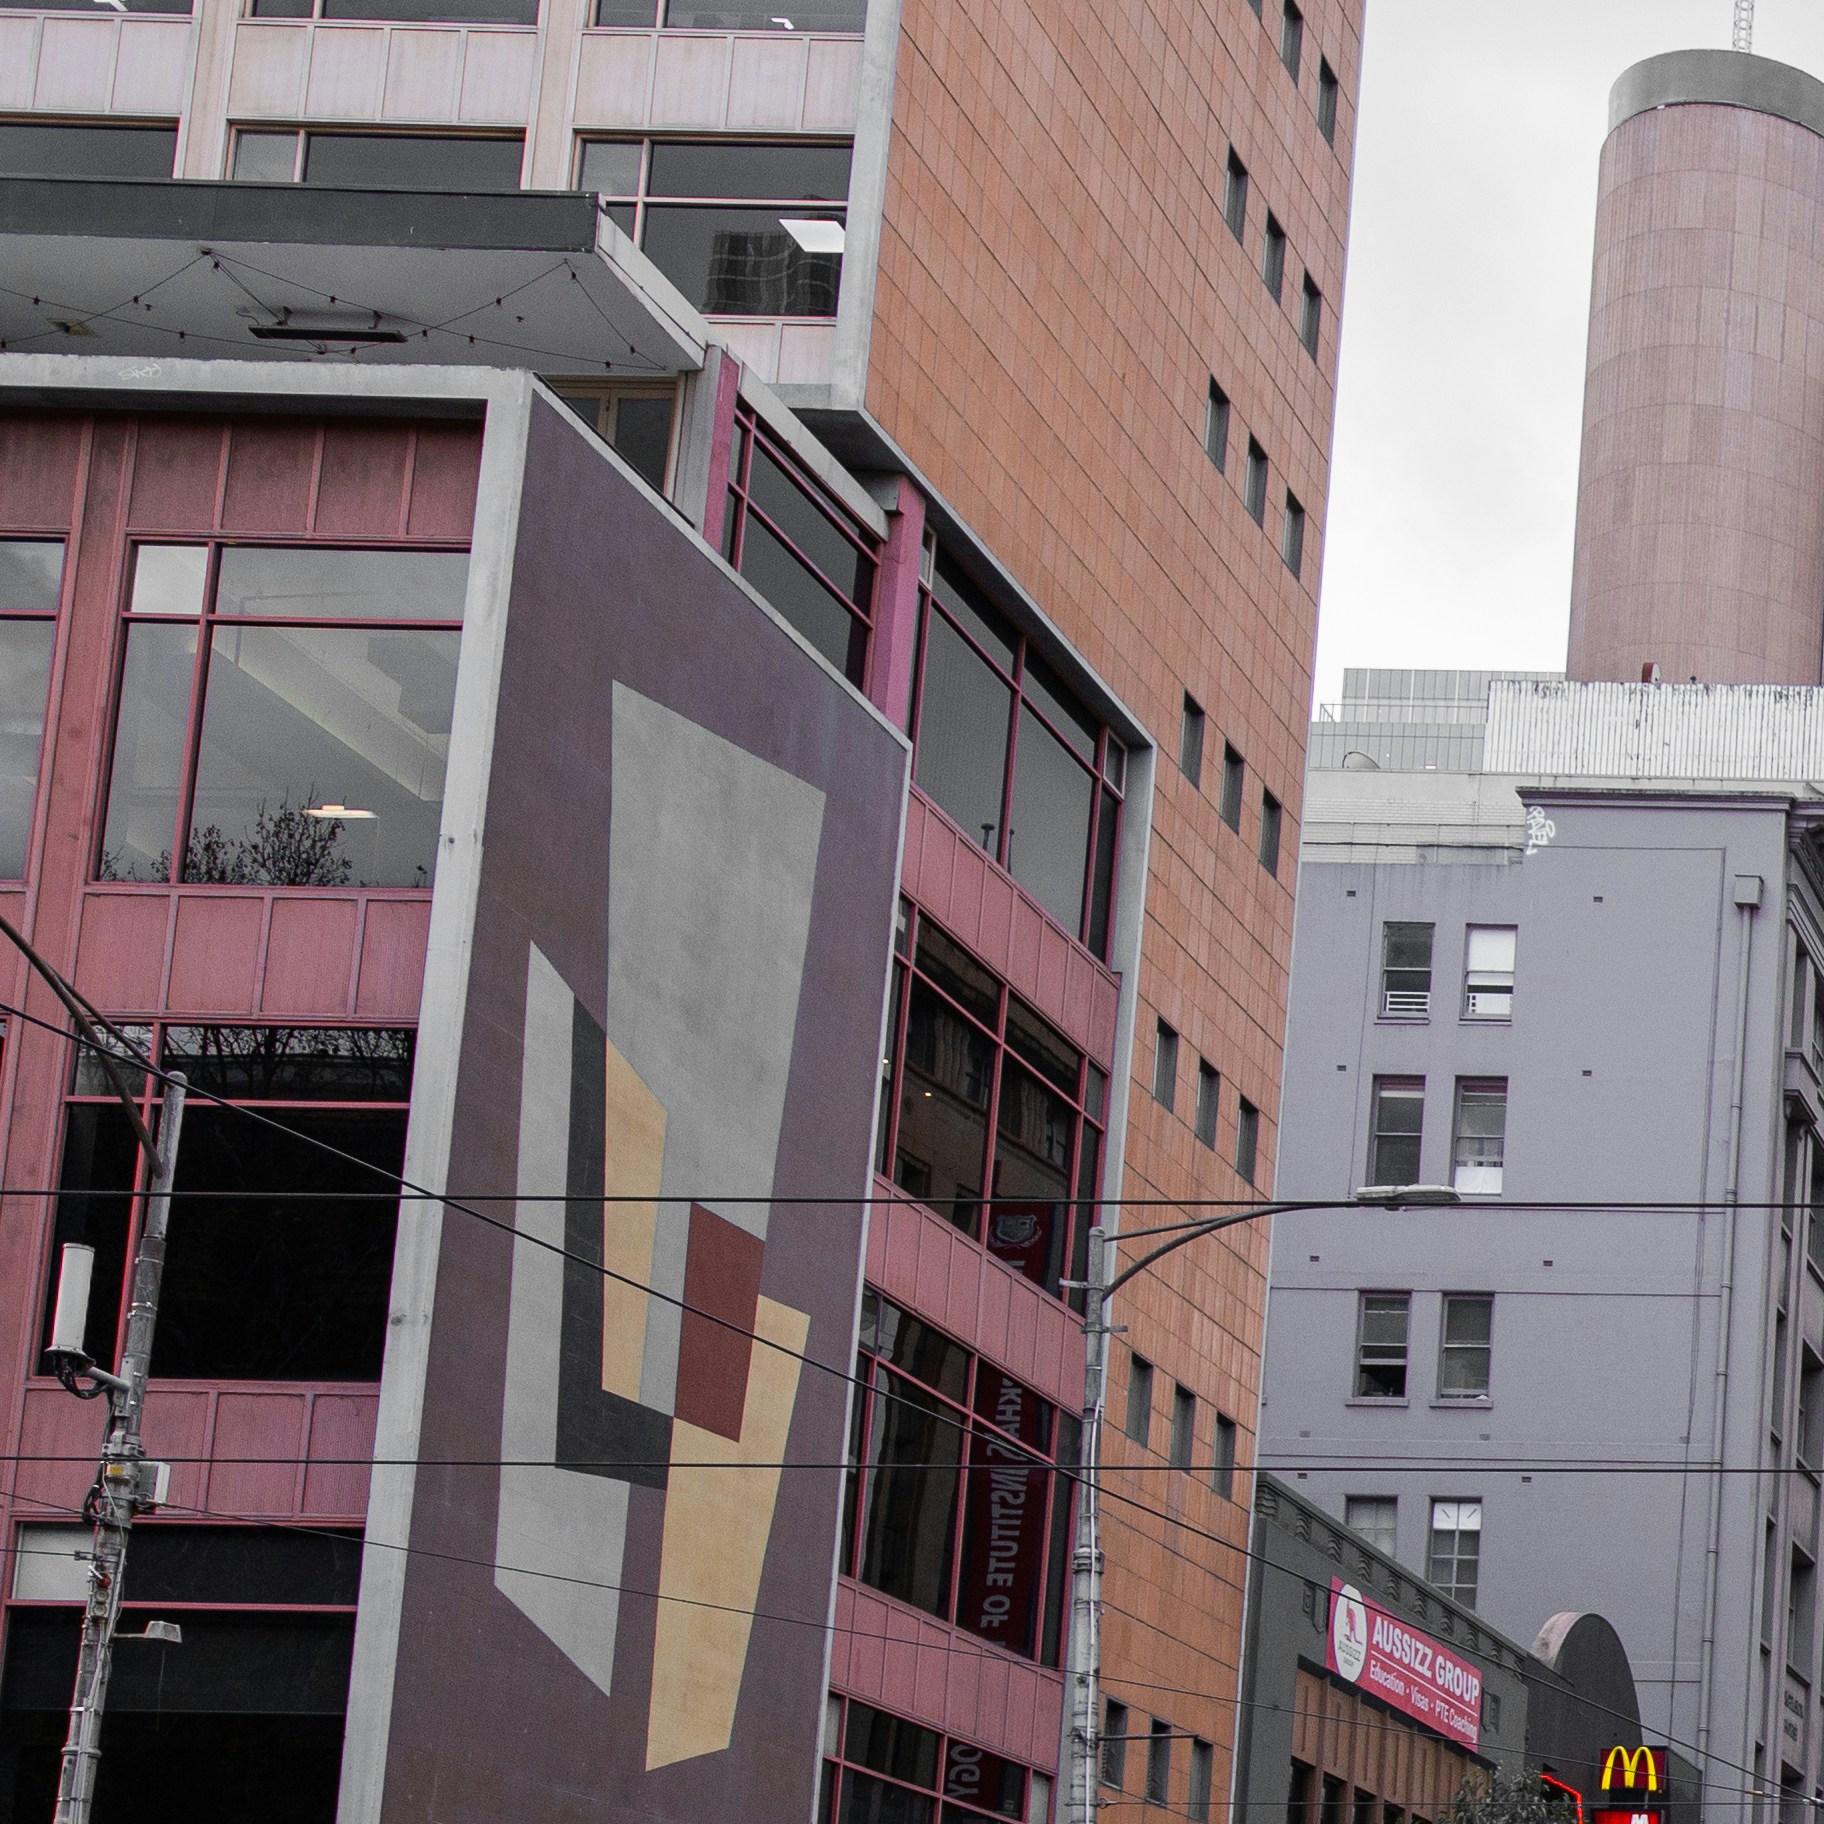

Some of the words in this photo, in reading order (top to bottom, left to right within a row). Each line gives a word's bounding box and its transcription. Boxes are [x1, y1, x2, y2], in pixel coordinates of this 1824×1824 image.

[1369, 1659, 1405, 1696] Education
[1411, 1685, 1430, 1712] Visas
[1435, 1700, 1449, 1724] PTE
[1449, 1708, 1478, 1743] Coaching
[1372, 1616, 1433, 1679] AUSSIZZ
[1435, 1655, 1480, 1707] GROUP
